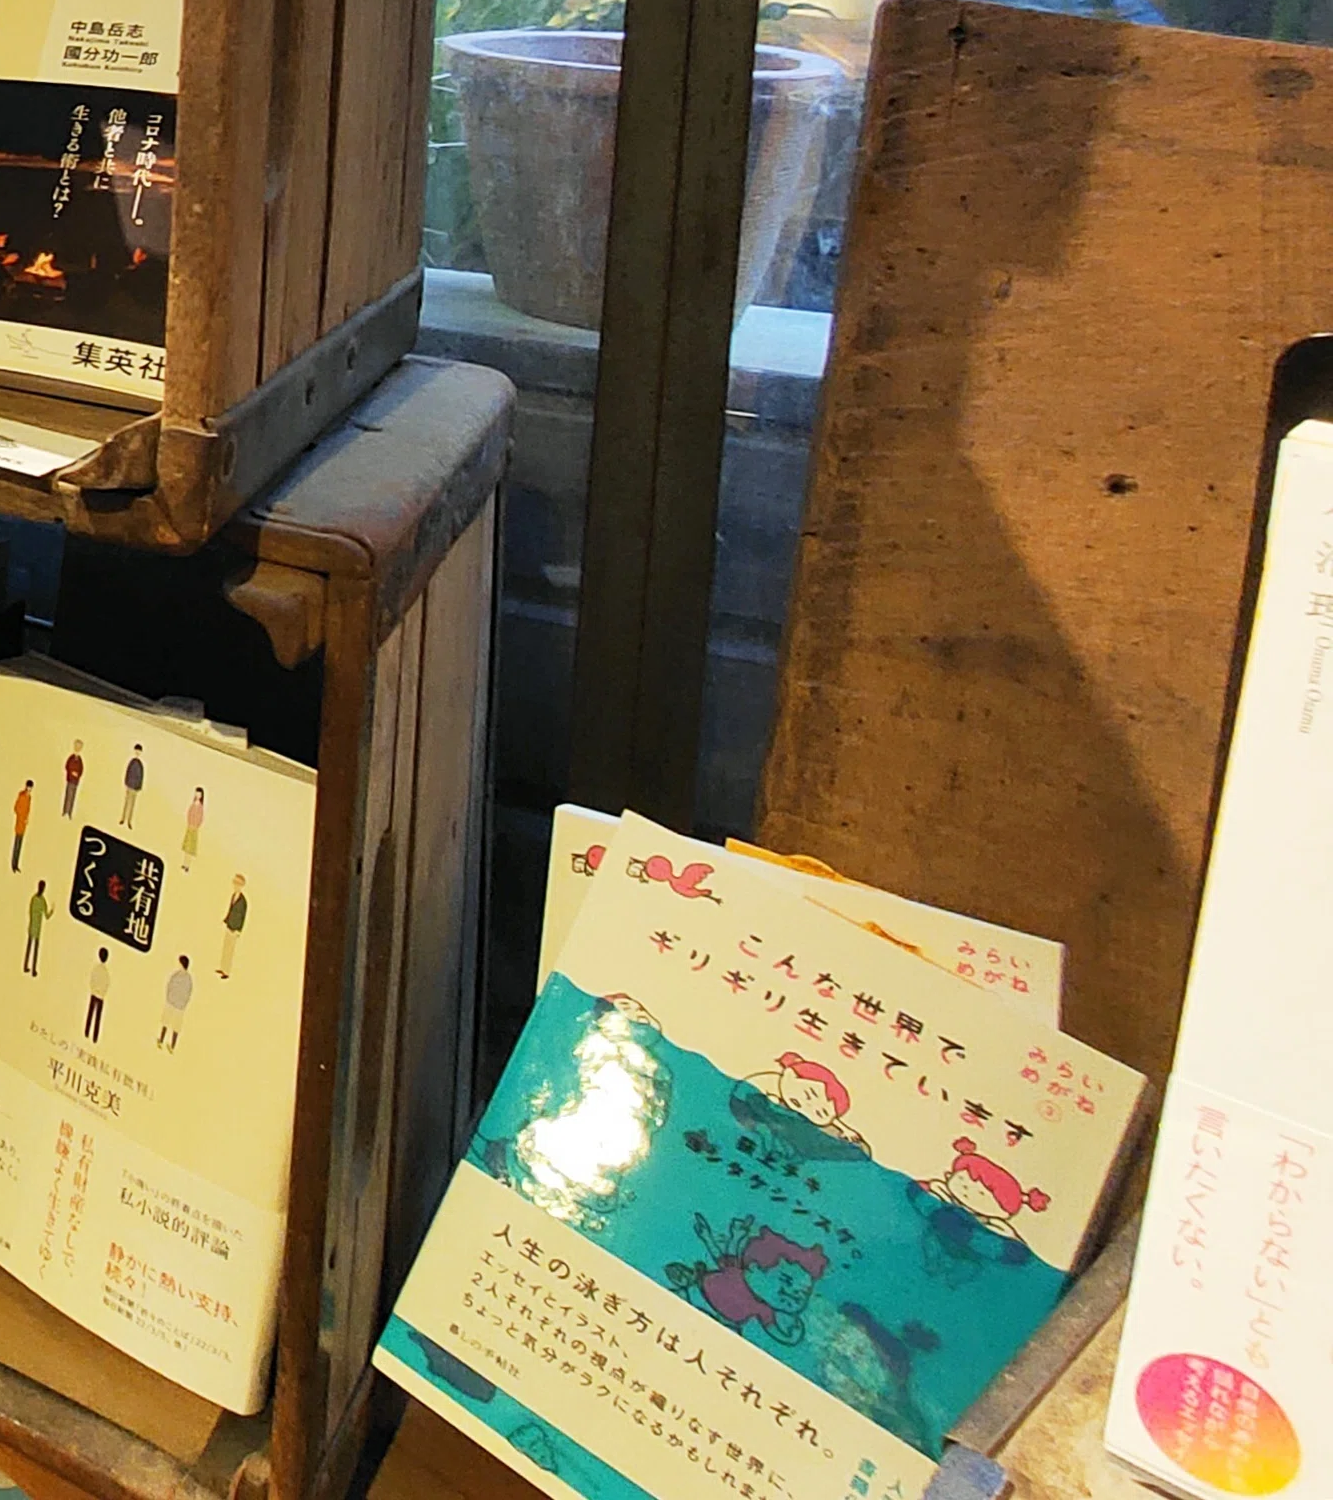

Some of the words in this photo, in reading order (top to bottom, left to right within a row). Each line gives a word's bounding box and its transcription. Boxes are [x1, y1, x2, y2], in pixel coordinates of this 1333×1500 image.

[62, 45, 159, 67] 國分功一郎
[69, 20, 145, 39] 中島岳志
[93, 106, 128, 190] 他者と共に
[73, 340, 166, 383] 集英社
[74, 833, 108, 918] つくる
[124, 858, 161, 946] 共有地
[955, 938, 1032, 972] みらい
[955, 961, 1032, 995] めがね
[648, 928, 1036, 1148] ギリギリ生きています
[737, 932, 969, 1068] こんな世界で
[46, 1055, 122, 1118] 平川克美
[1019, 1064, 1098, 1117] めがね
[1027, 1045, 1105, 1095] みらい
[120, 1186, 232, 1261] 私小説的評論
[1172, 1104, 1230, 1291] 言いたくない。
[107, 1240, 241, 1328] 静かに熱い支持、
[481, 1251, 630, 1360] エッセイとイラスト、
[492, 1224, 835, 1460] 人生の泳ぎ方は人それぞれ。
